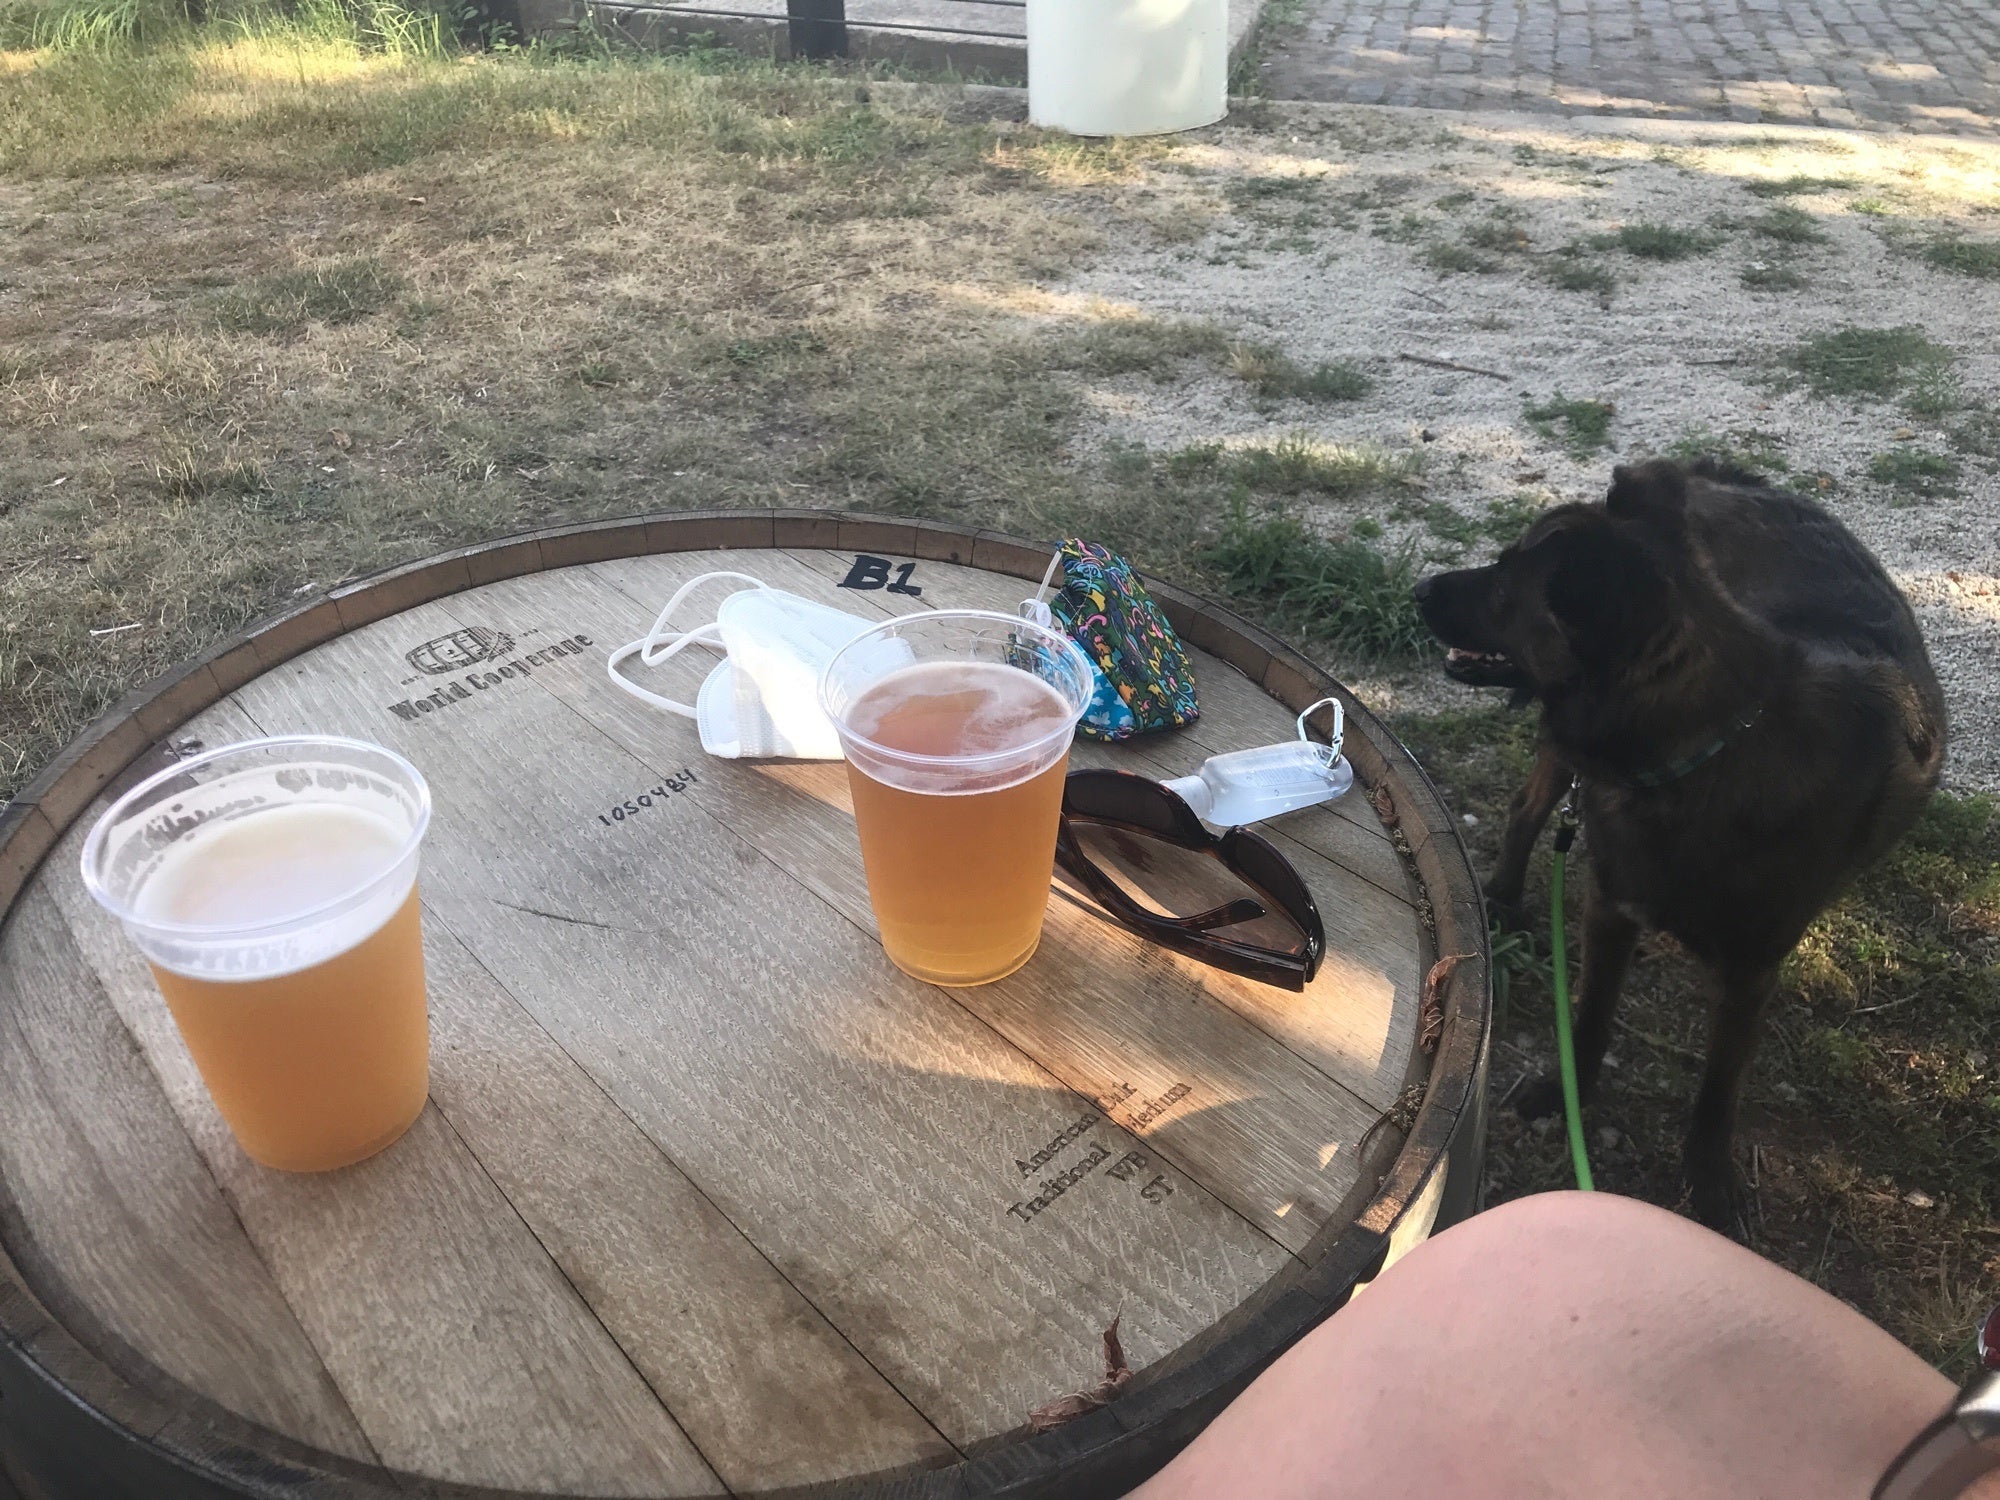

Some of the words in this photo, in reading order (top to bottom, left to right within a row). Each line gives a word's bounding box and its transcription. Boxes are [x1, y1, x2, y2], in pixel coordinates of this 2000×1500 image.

[837, 555, 922, 596] B1
[387, 681, 472, 721] World
[466, 633, 594, 691] Cooperage
[1015, 1113, 1101, 1179] American
[1105, 1151, 1148, 1181] WB
[1006, 1141, 1111, 1223] Traditional
[1141, 1175, 1174, 1204] ST
